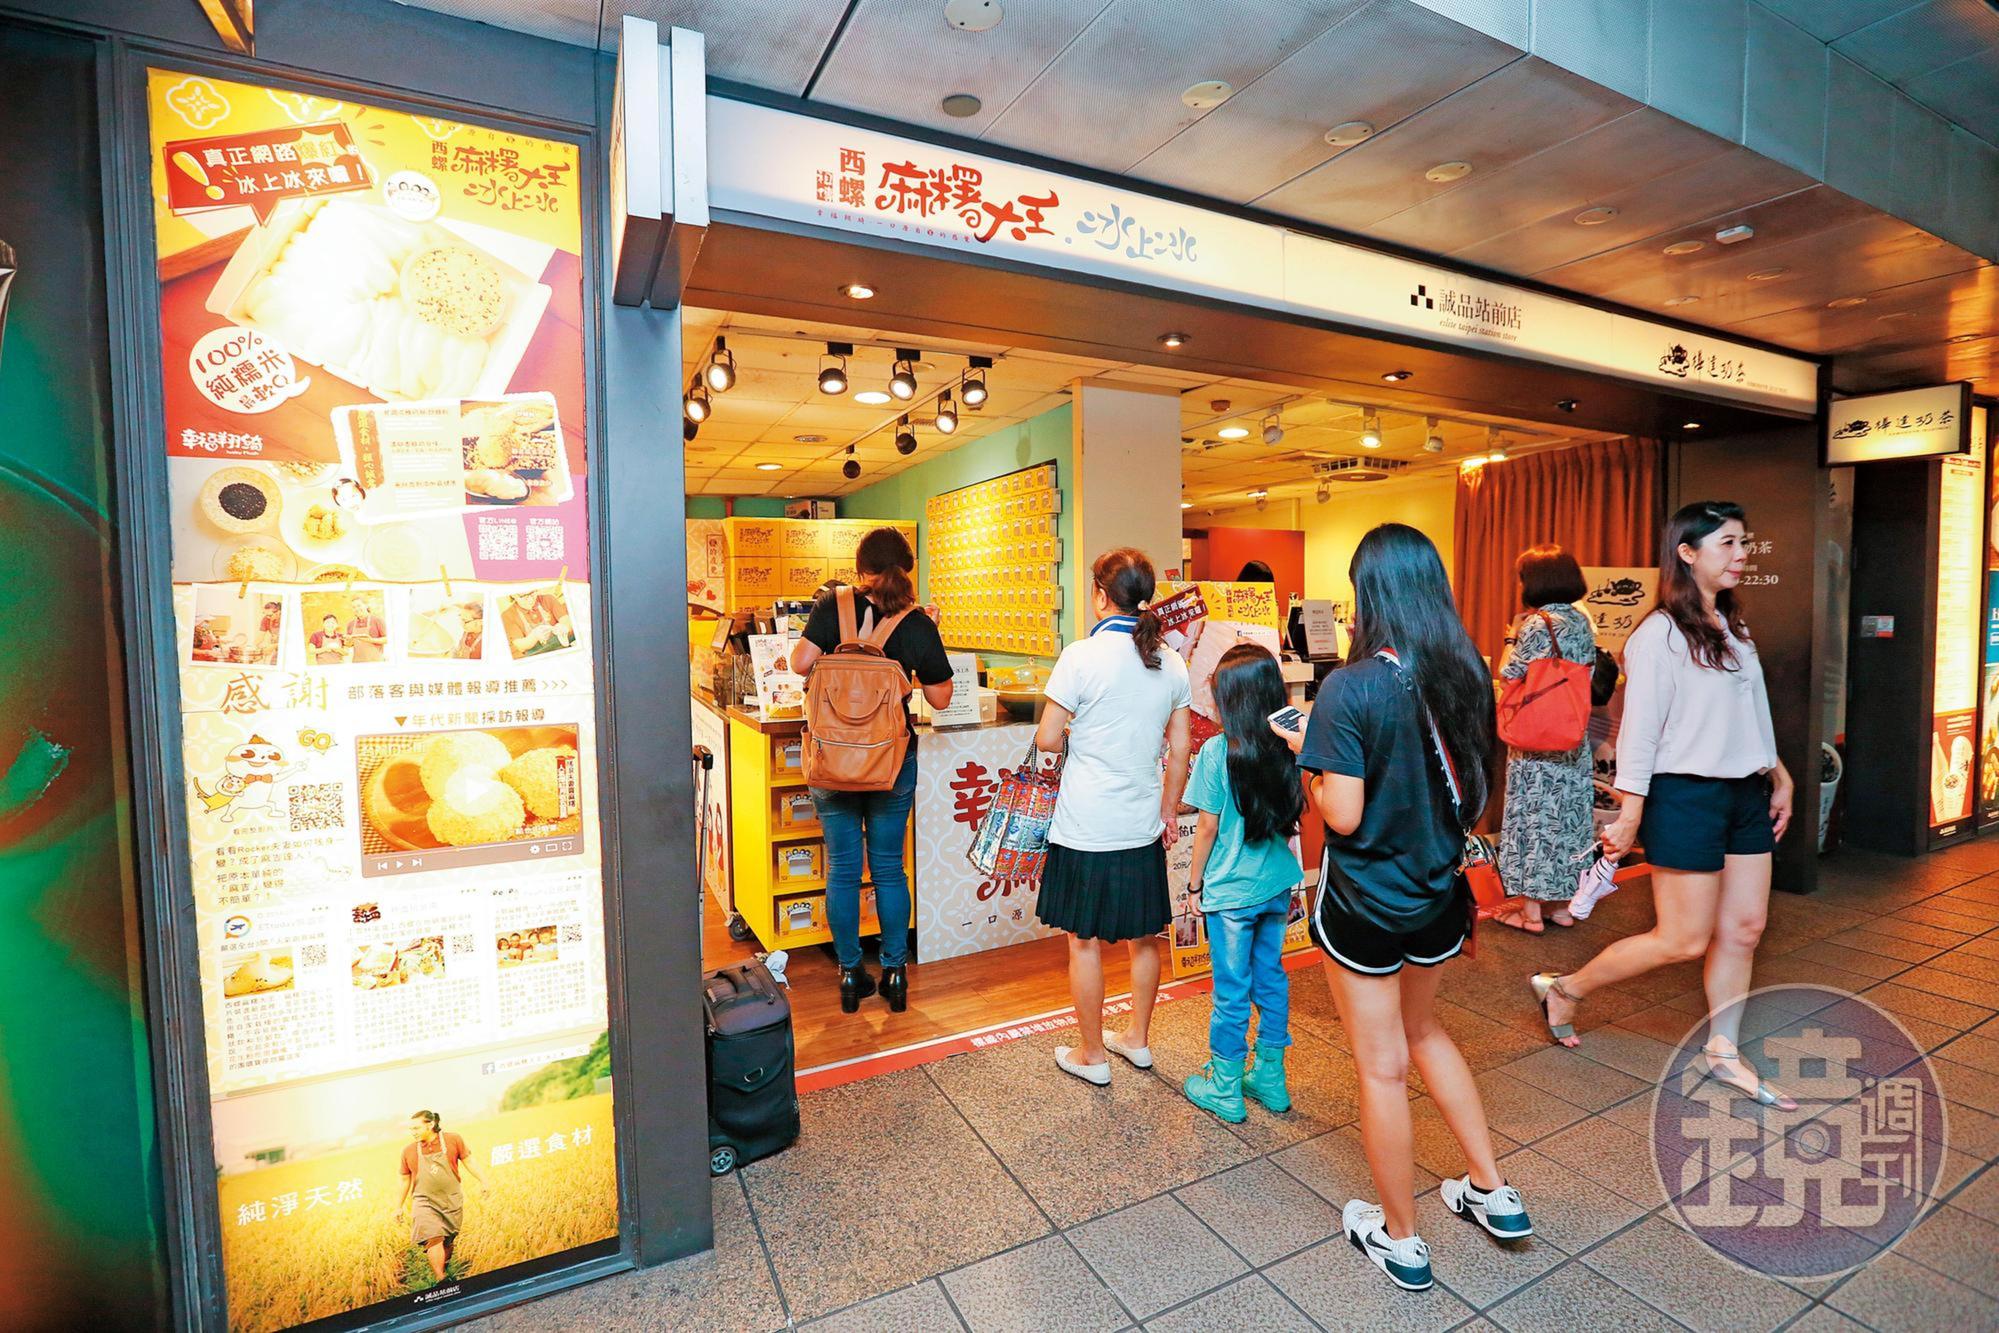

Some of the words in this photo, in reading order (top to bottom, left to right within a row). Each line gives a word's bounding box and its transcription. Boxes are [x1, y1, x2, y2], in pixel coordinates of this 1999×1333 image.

[432, 141, 447, 172] 西螺
[839, 147, 866, 208] 西螺
[874, 160, 1060, 244] 麻糬大王
[1076, 203, 1199, 264] 冰上冰
[1439, 289, 1522, 330] 誠品站前店
[197, 330, 264, 375] 100%
[205, 347, 287, 401] 純糯米
[221, 672, 329, 716] 感謝
[348, 679, 538, 701] 部落客與媒體報導推薦
[298, 729, 333, 752] GO
[490, 1124, 594, 1168] 嚴選食材
[237, 1177, 365, 1226] 純淨天然
